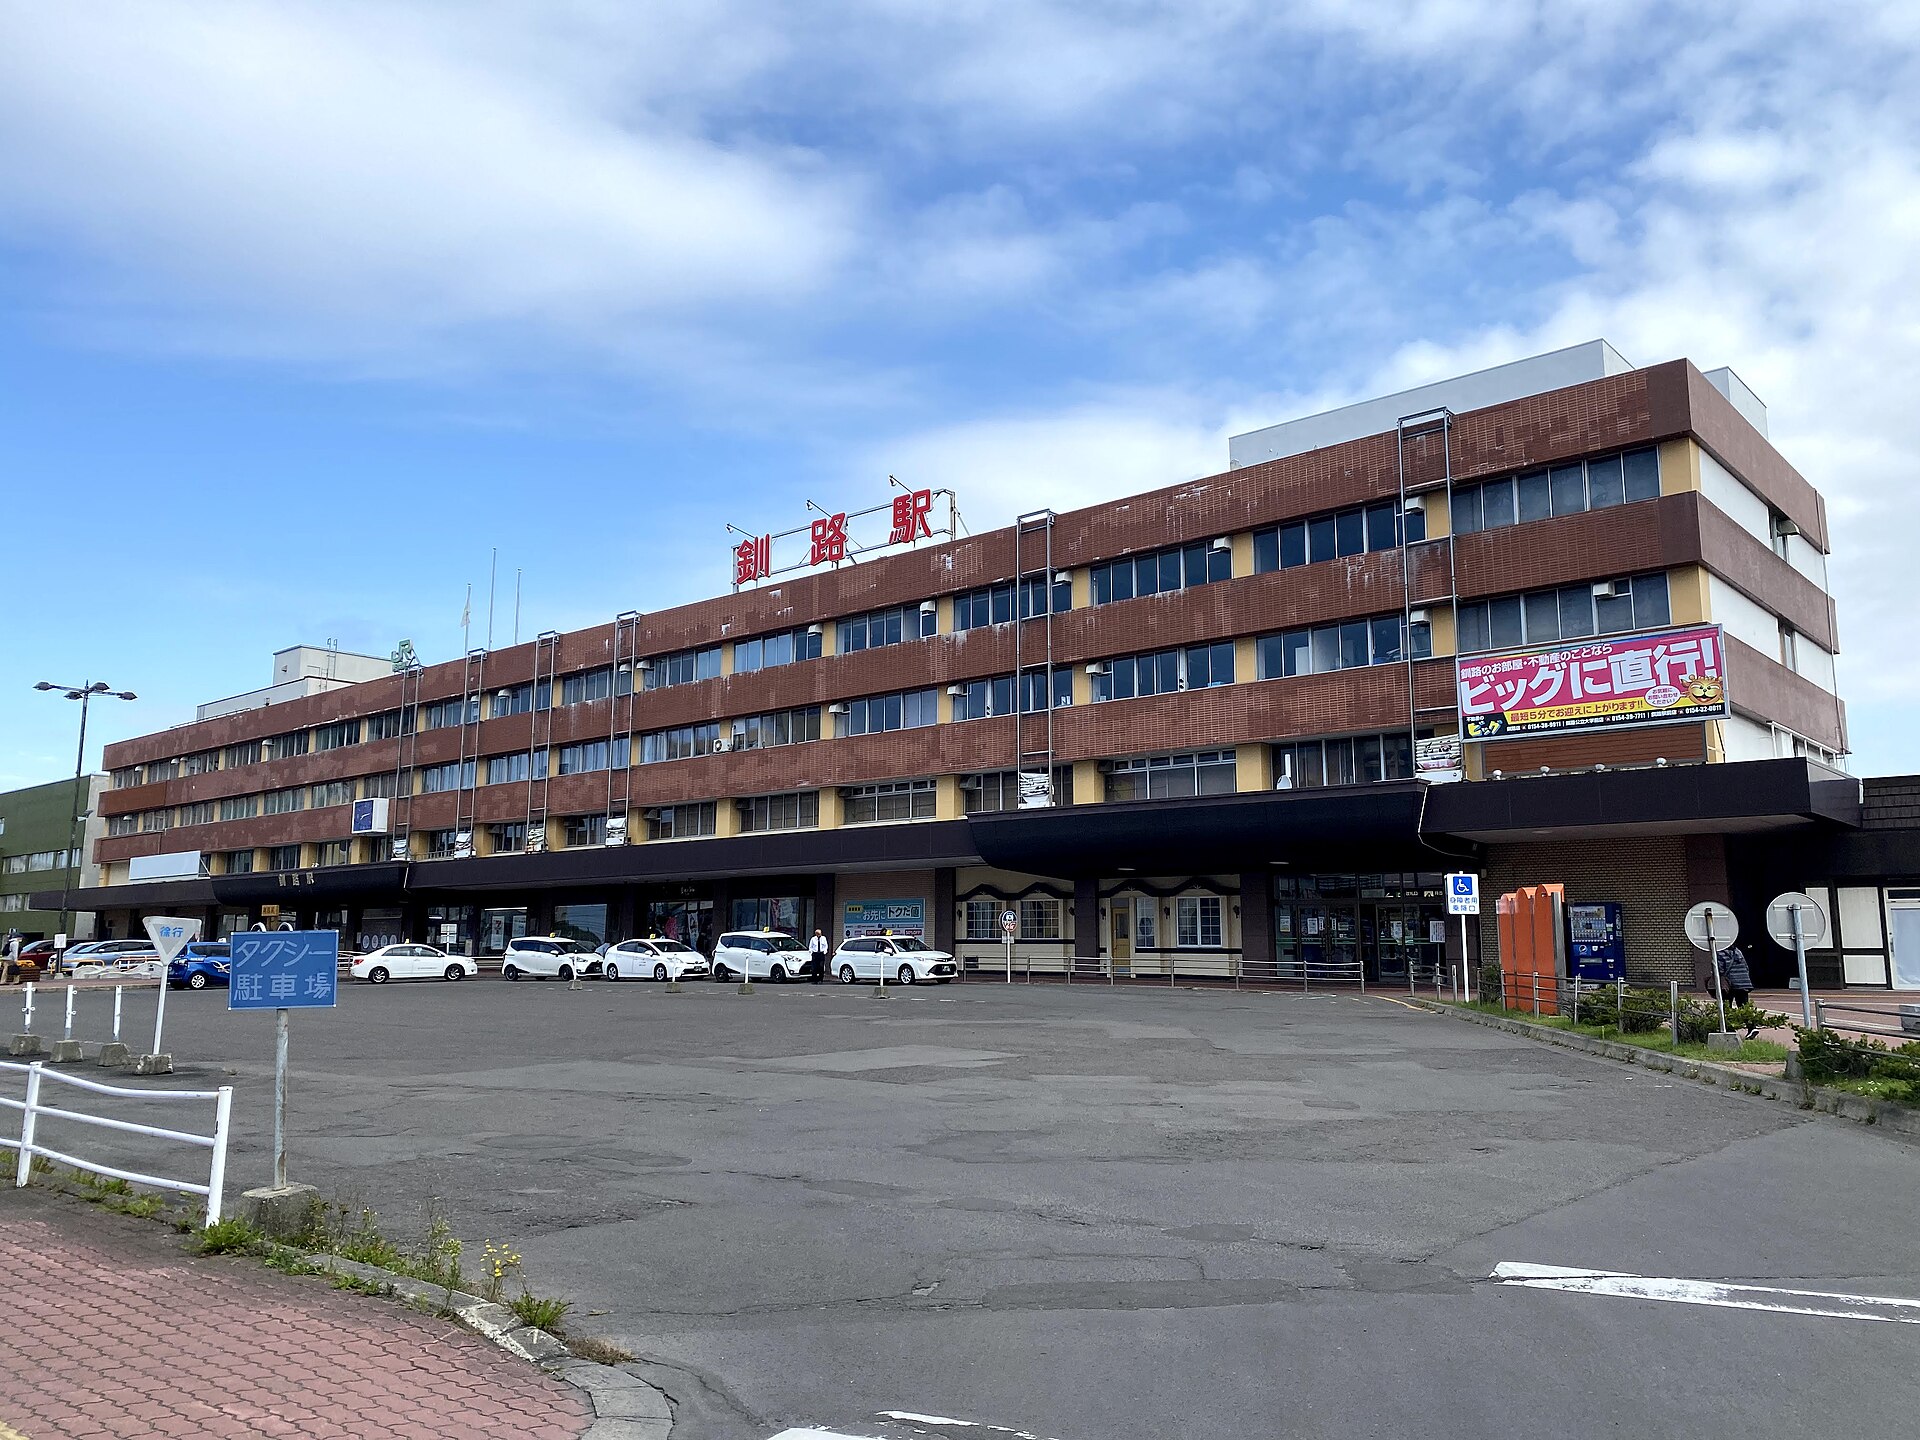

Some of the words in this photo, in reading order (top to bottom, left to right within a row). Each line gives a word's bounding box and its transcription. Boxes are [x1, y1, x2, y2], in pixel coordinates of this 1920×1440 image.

[736, 489, 933, 585] 釧路駅
[1460, 644, 1613, 679] 釧路のお部屋・不動産のことなら
[1467, 719, 1503, 737] ビッグ
[862, 909, 886, 921] お先に
[160, 925, 183, 938] 徐行
[235, 939, 333, 968] タクシー
[233, 972, 332, 1001] 駐車場
